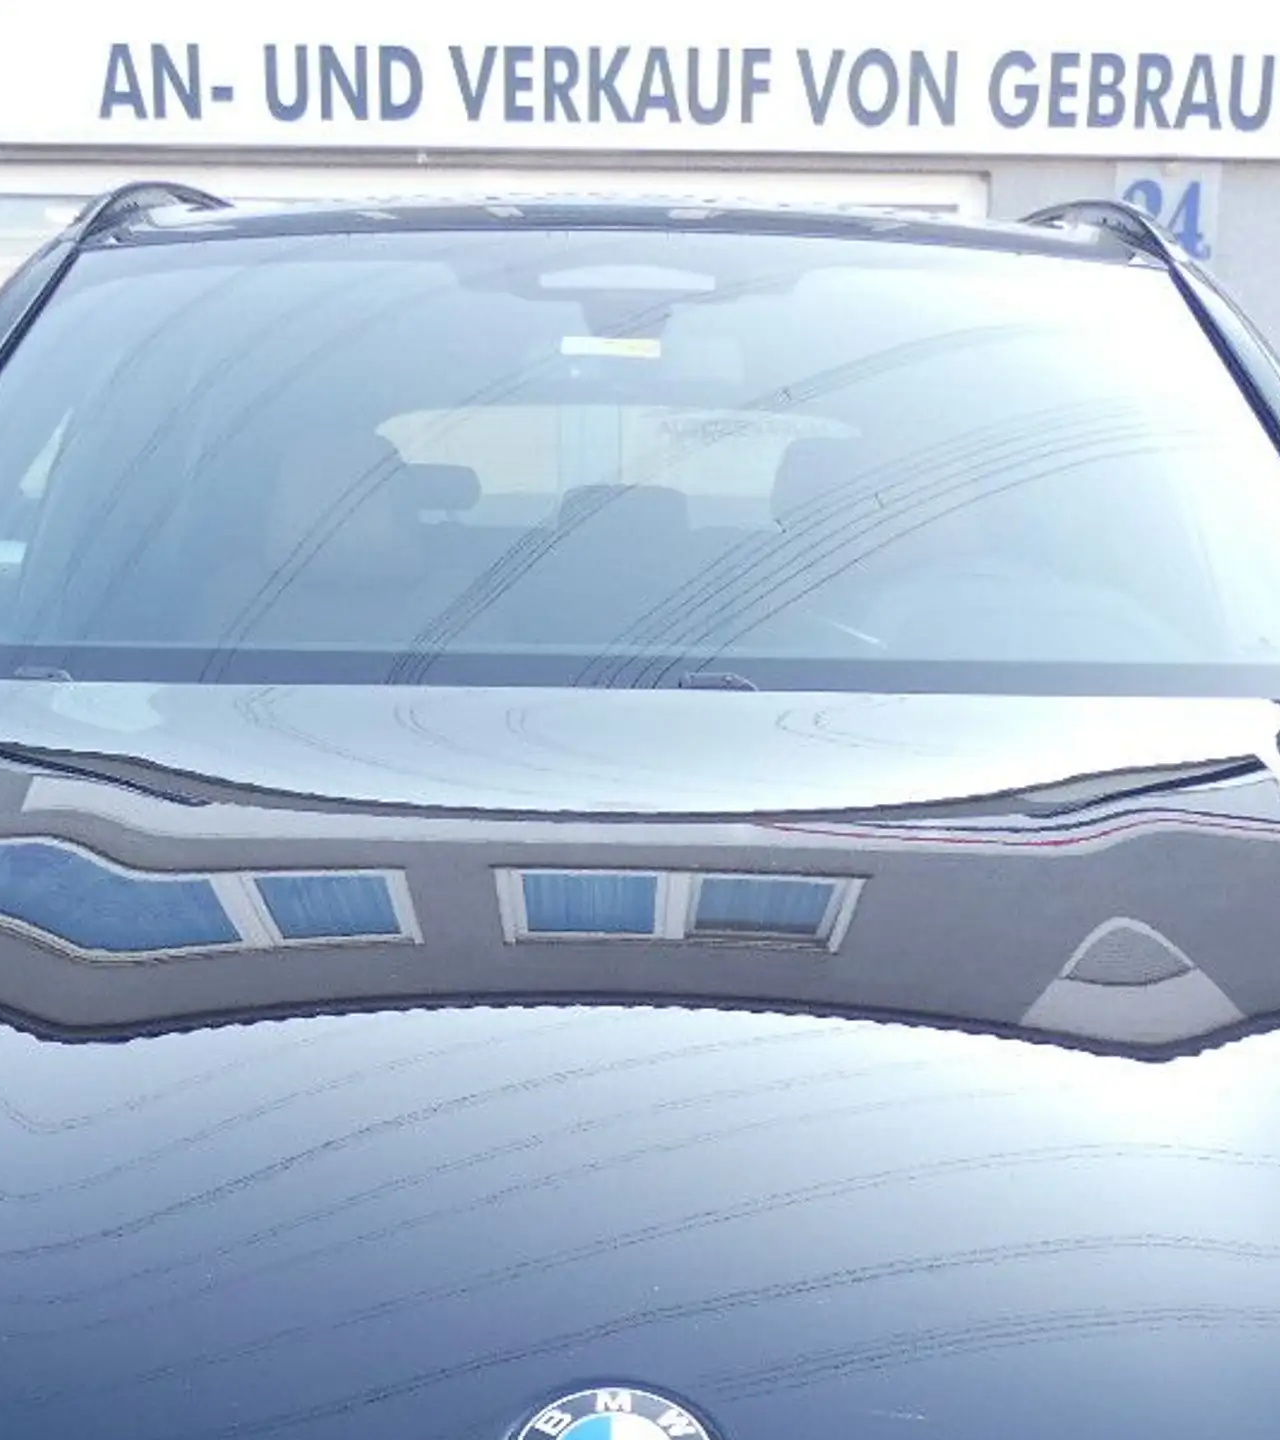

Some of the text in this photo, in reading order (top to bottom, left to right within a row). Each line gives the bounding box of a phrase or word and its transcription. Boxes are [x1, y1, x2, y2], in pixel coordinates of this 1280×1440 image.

[99, 43, 235, 122] AN-
[264, 43, 424, 124] UND
[448, 45, 773, 127] VERKAUF
[796, 48, 959, 129] VON
[533, 1390, 697, 1437] BMW
